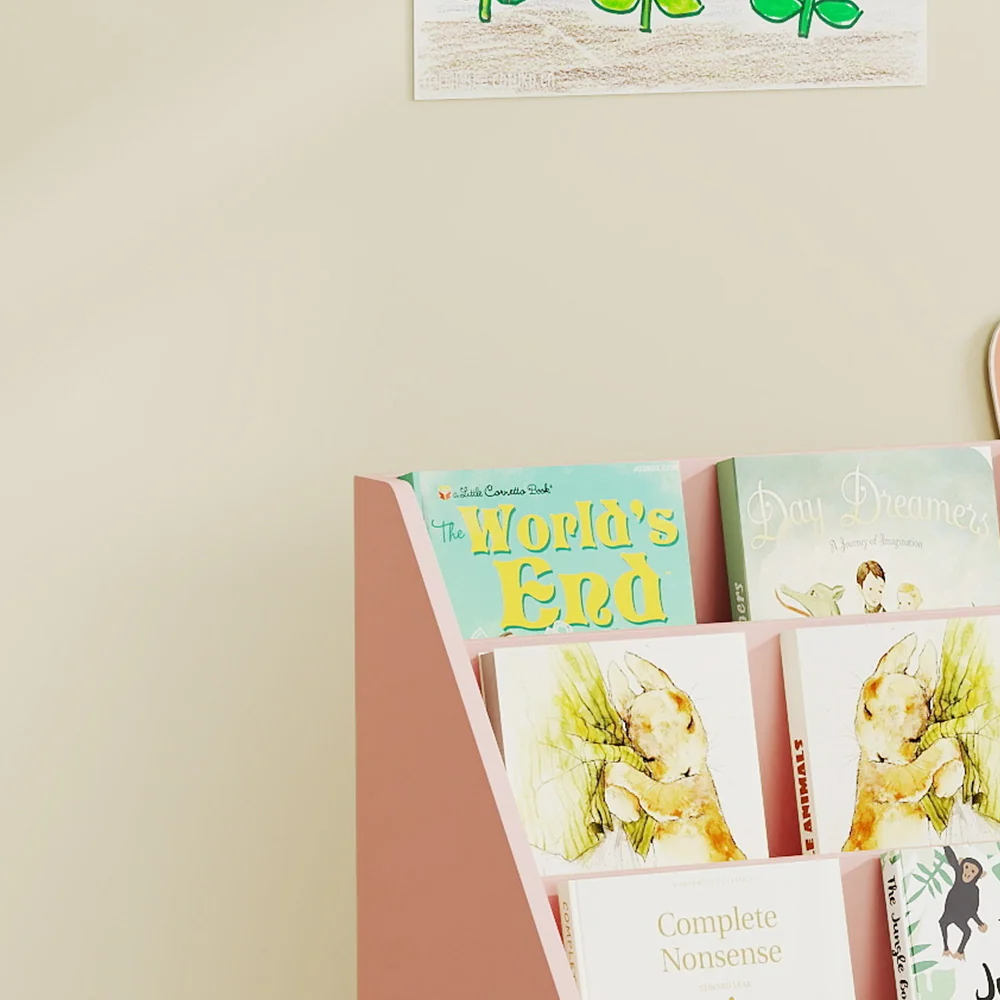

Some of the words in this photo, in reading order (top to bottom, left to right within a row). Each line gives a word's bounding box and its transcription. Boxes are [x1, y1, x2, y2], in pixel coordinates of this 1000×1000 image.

[460, 486, 483, 499] Little
[528, 483, 550, 495] Book
[746, 480, 825, 550] Day
[839, 463, 991, 538] Dreamers
[431, 518, 466, 544] The
[457, 498, 680, 556] World's
[492, 552, 669, 632] End
[794, 737, 814, 834] ANIMALS
[887, 875, 897, 907] The
[657, 905, 778, 940] Complete
[890, 912, 906, 974] Jungle
[660, 943, 783, 973] Nonsense
